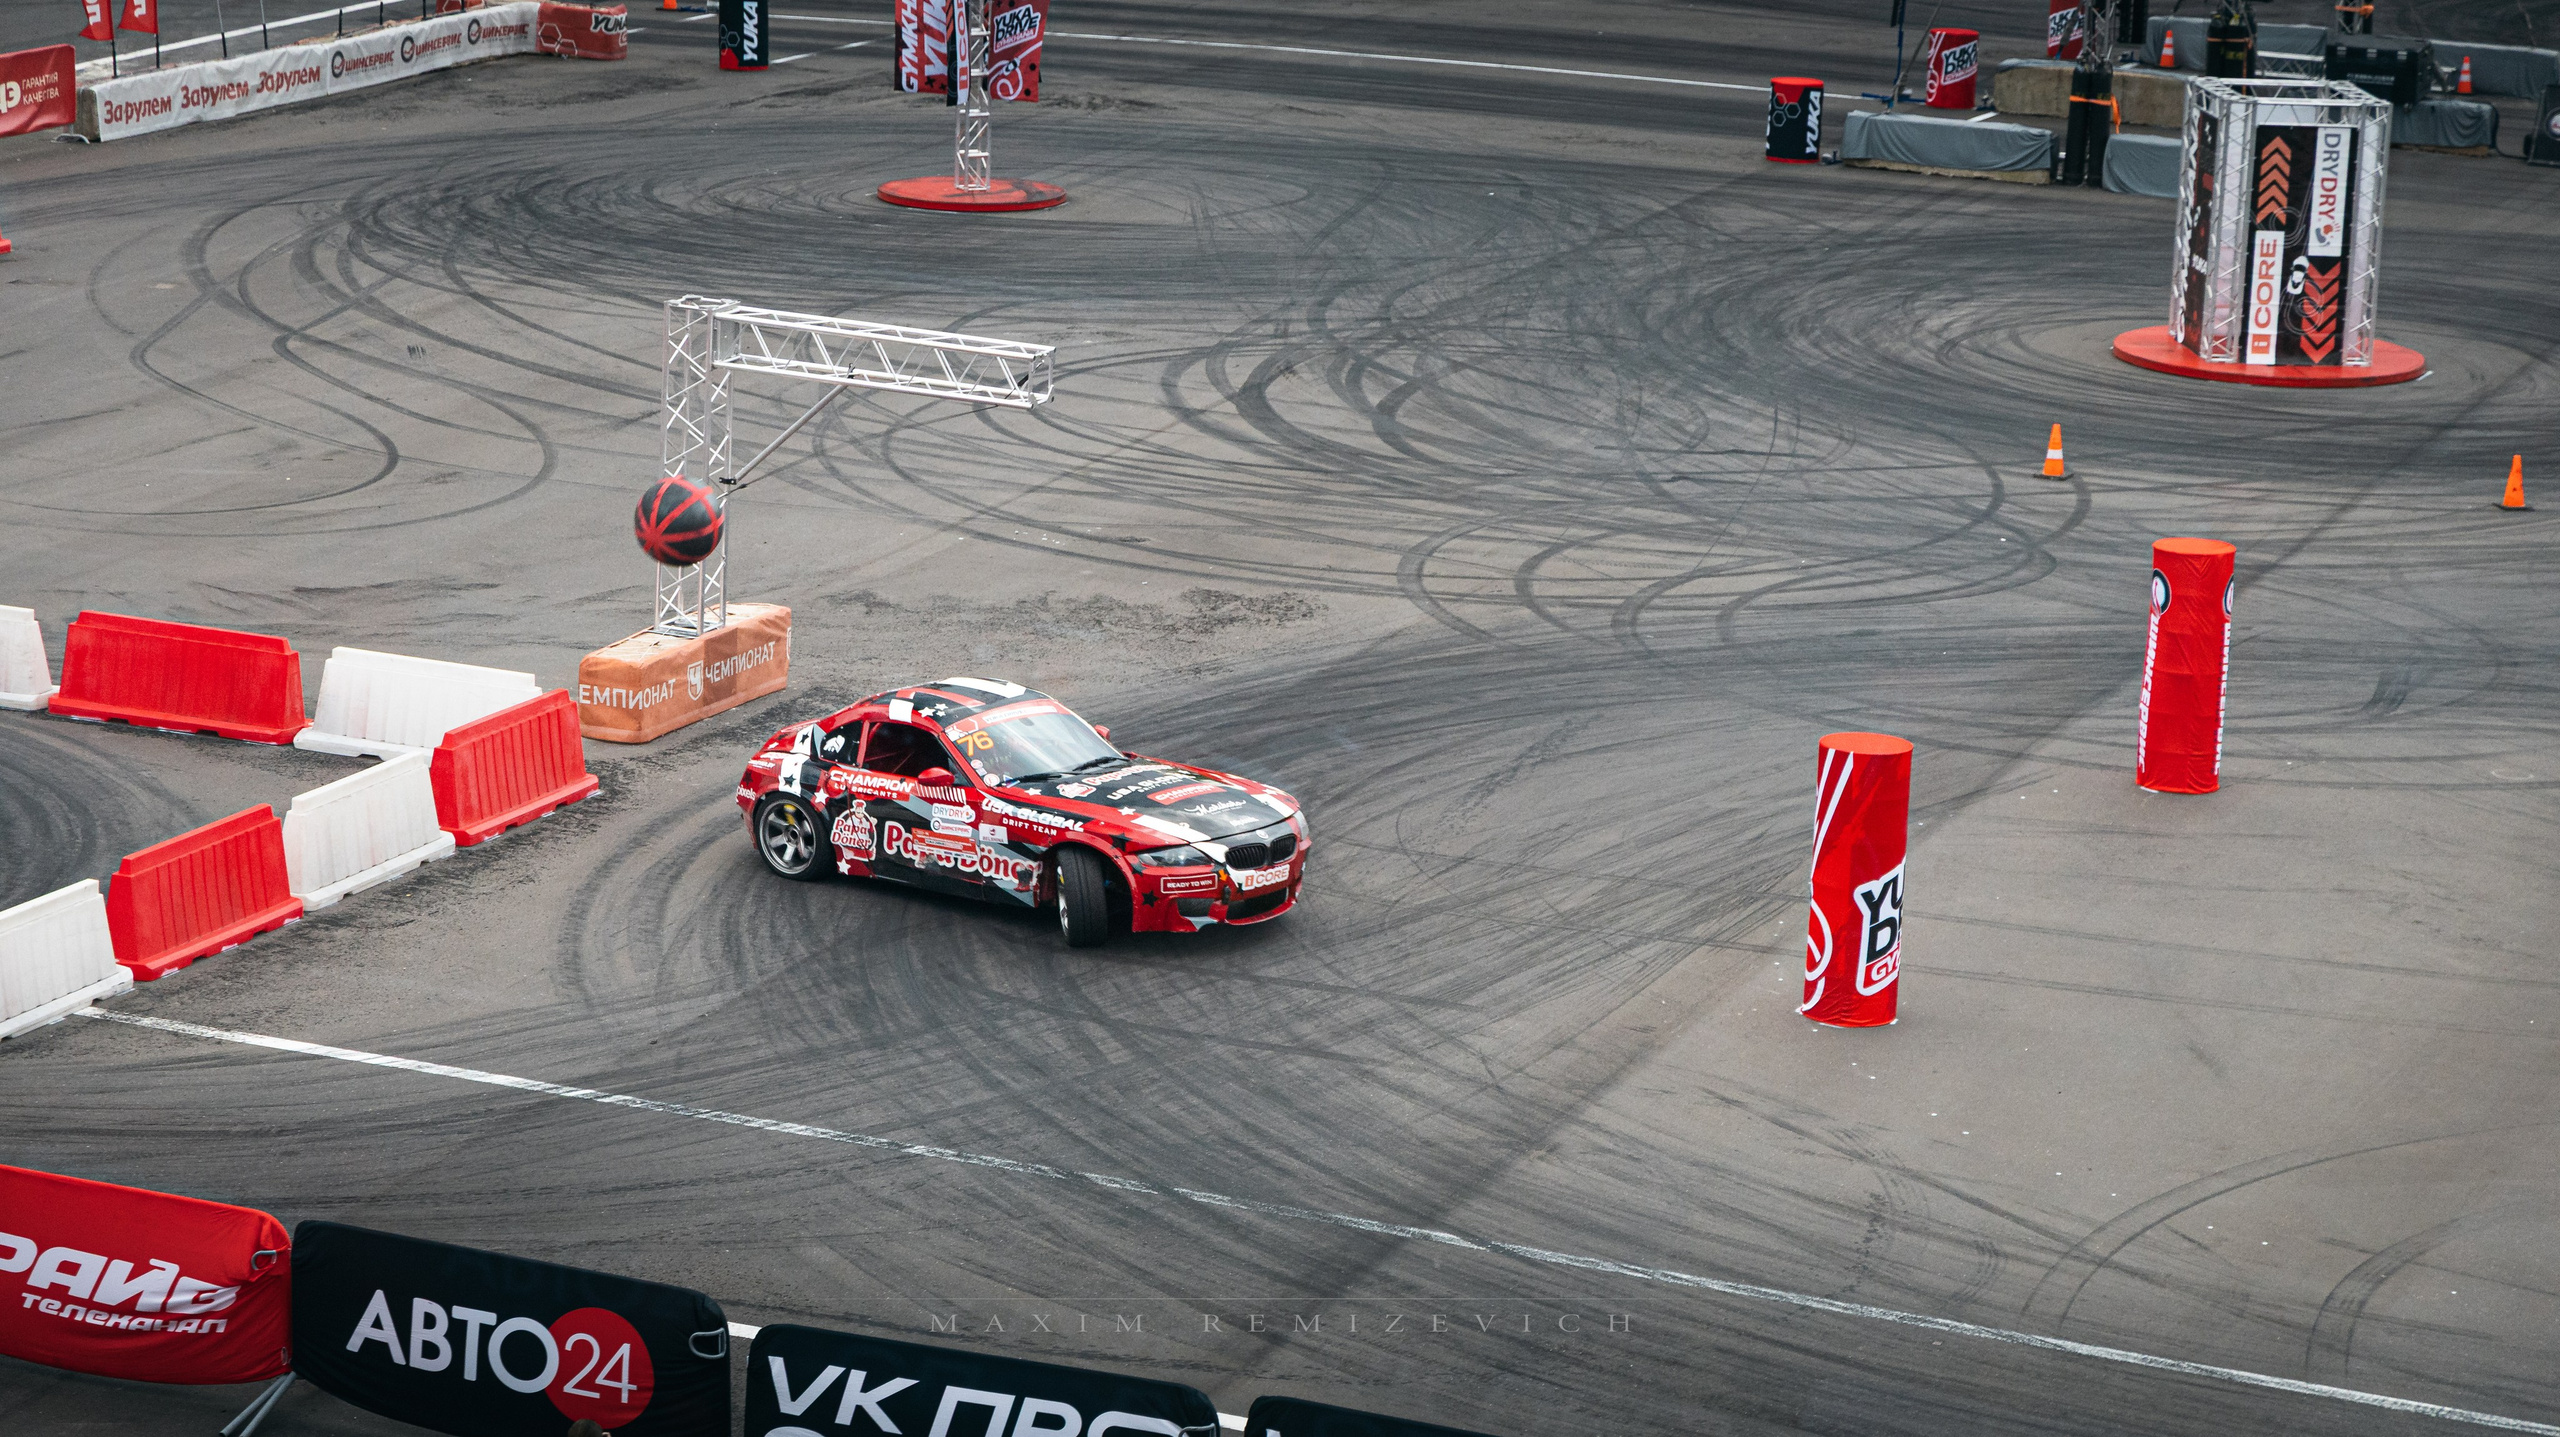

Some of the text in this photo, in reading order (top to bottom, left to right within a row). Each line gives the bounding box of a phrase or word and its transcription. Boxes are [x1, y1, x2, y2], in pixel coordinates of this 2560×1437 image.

[995, 6, 1032, 30] YUKA
[996, 15, 1039, 42] DRIVE
[742, 0, 759, 62] YUKA
[415, 32, 463, 56] ШИНСЕРВИС
[901, 0, 919, 93] GYMKH
[344, 50, 396, 72] ШИНСЕРВИС
[22, 71, 59, 91] ГАРАНТИЯ
[23, 87, 60, 106] КАЧЕСТВА
[1804, 90, 1821, 154] YUKA
[2317, 132, 2342, 222] DRYDRY
[705, 641, 776, 685] ЧЕМПИОНАТ
[2138, 612, 2160, 774] ШИНСЕРВИС
[956, 730, 995, 757] 76
[830, 769, 915, 793] CHAMPION
[1107, 783, 1143, 800] USA
[1154, 784, 1215, 801] CHAMPION
[934, 805, 964, 819] DRYDRY
[982, 799, 1084, 832] USA GLOBAL
[835, 818, 869, 836] Papa
[1002, 817, 1057, 836] DRIFT TEAM
[831, 831, 873, 850] Döner
[1166, 878, 1213, 889] READY TO WIN
[768, 1355, 920, 1435] VK
